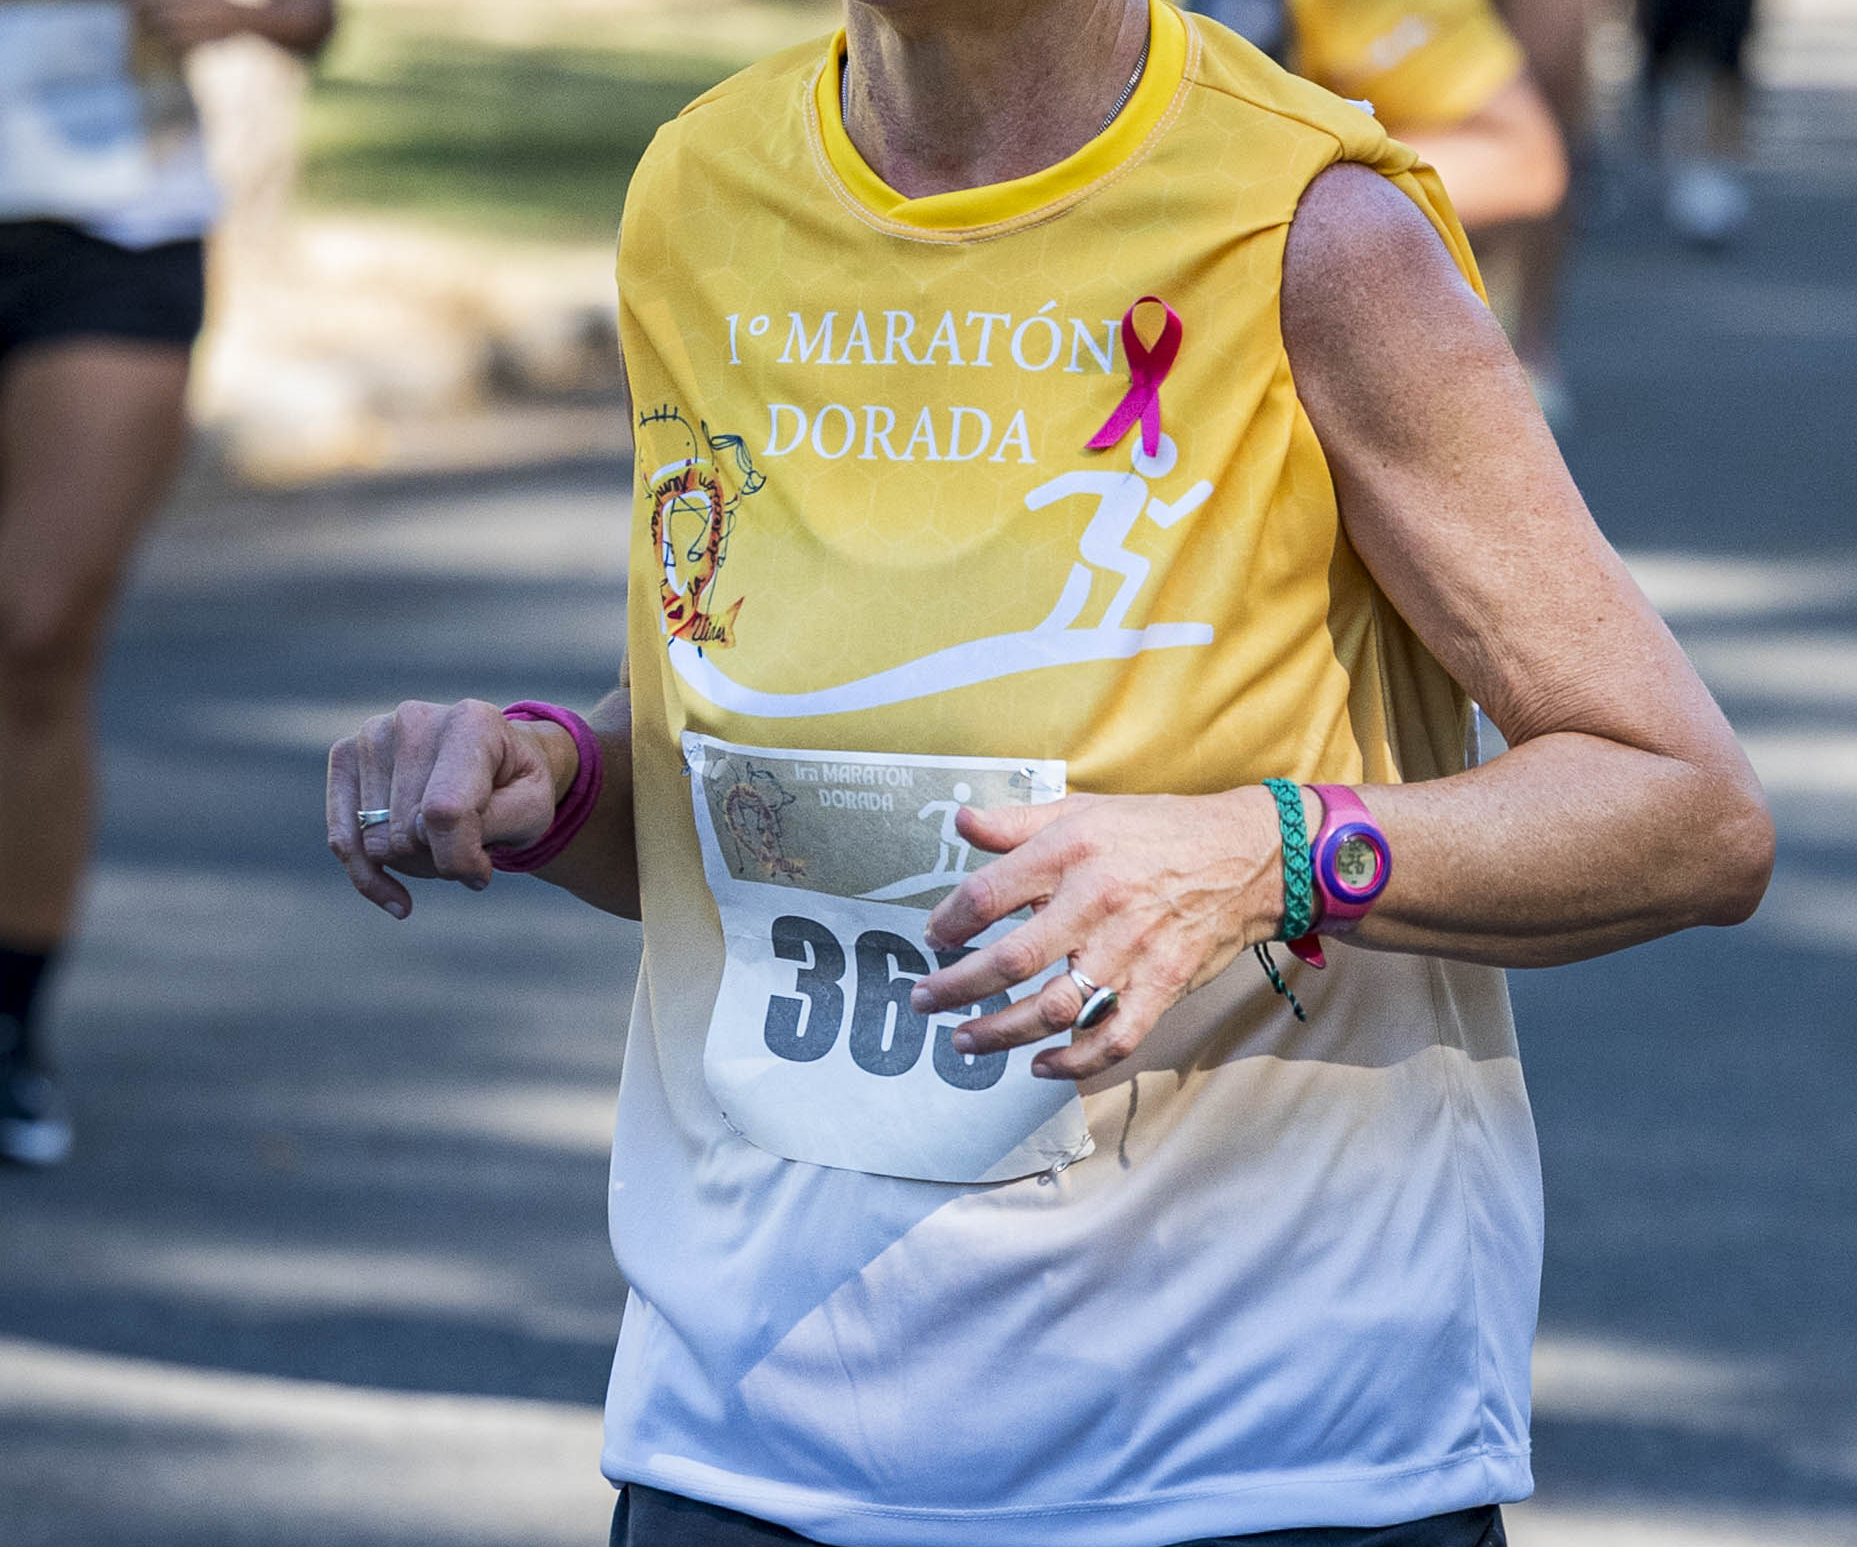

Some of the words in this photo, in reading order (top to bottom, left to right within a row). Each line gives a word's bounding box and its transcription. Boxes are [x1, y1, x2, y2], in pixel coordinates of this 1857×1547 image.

[776, 299, 1122, 375] MARATÓN
[760, 403, 1037, 464] DORADA
[818, 788, 894, 812] DORADA
